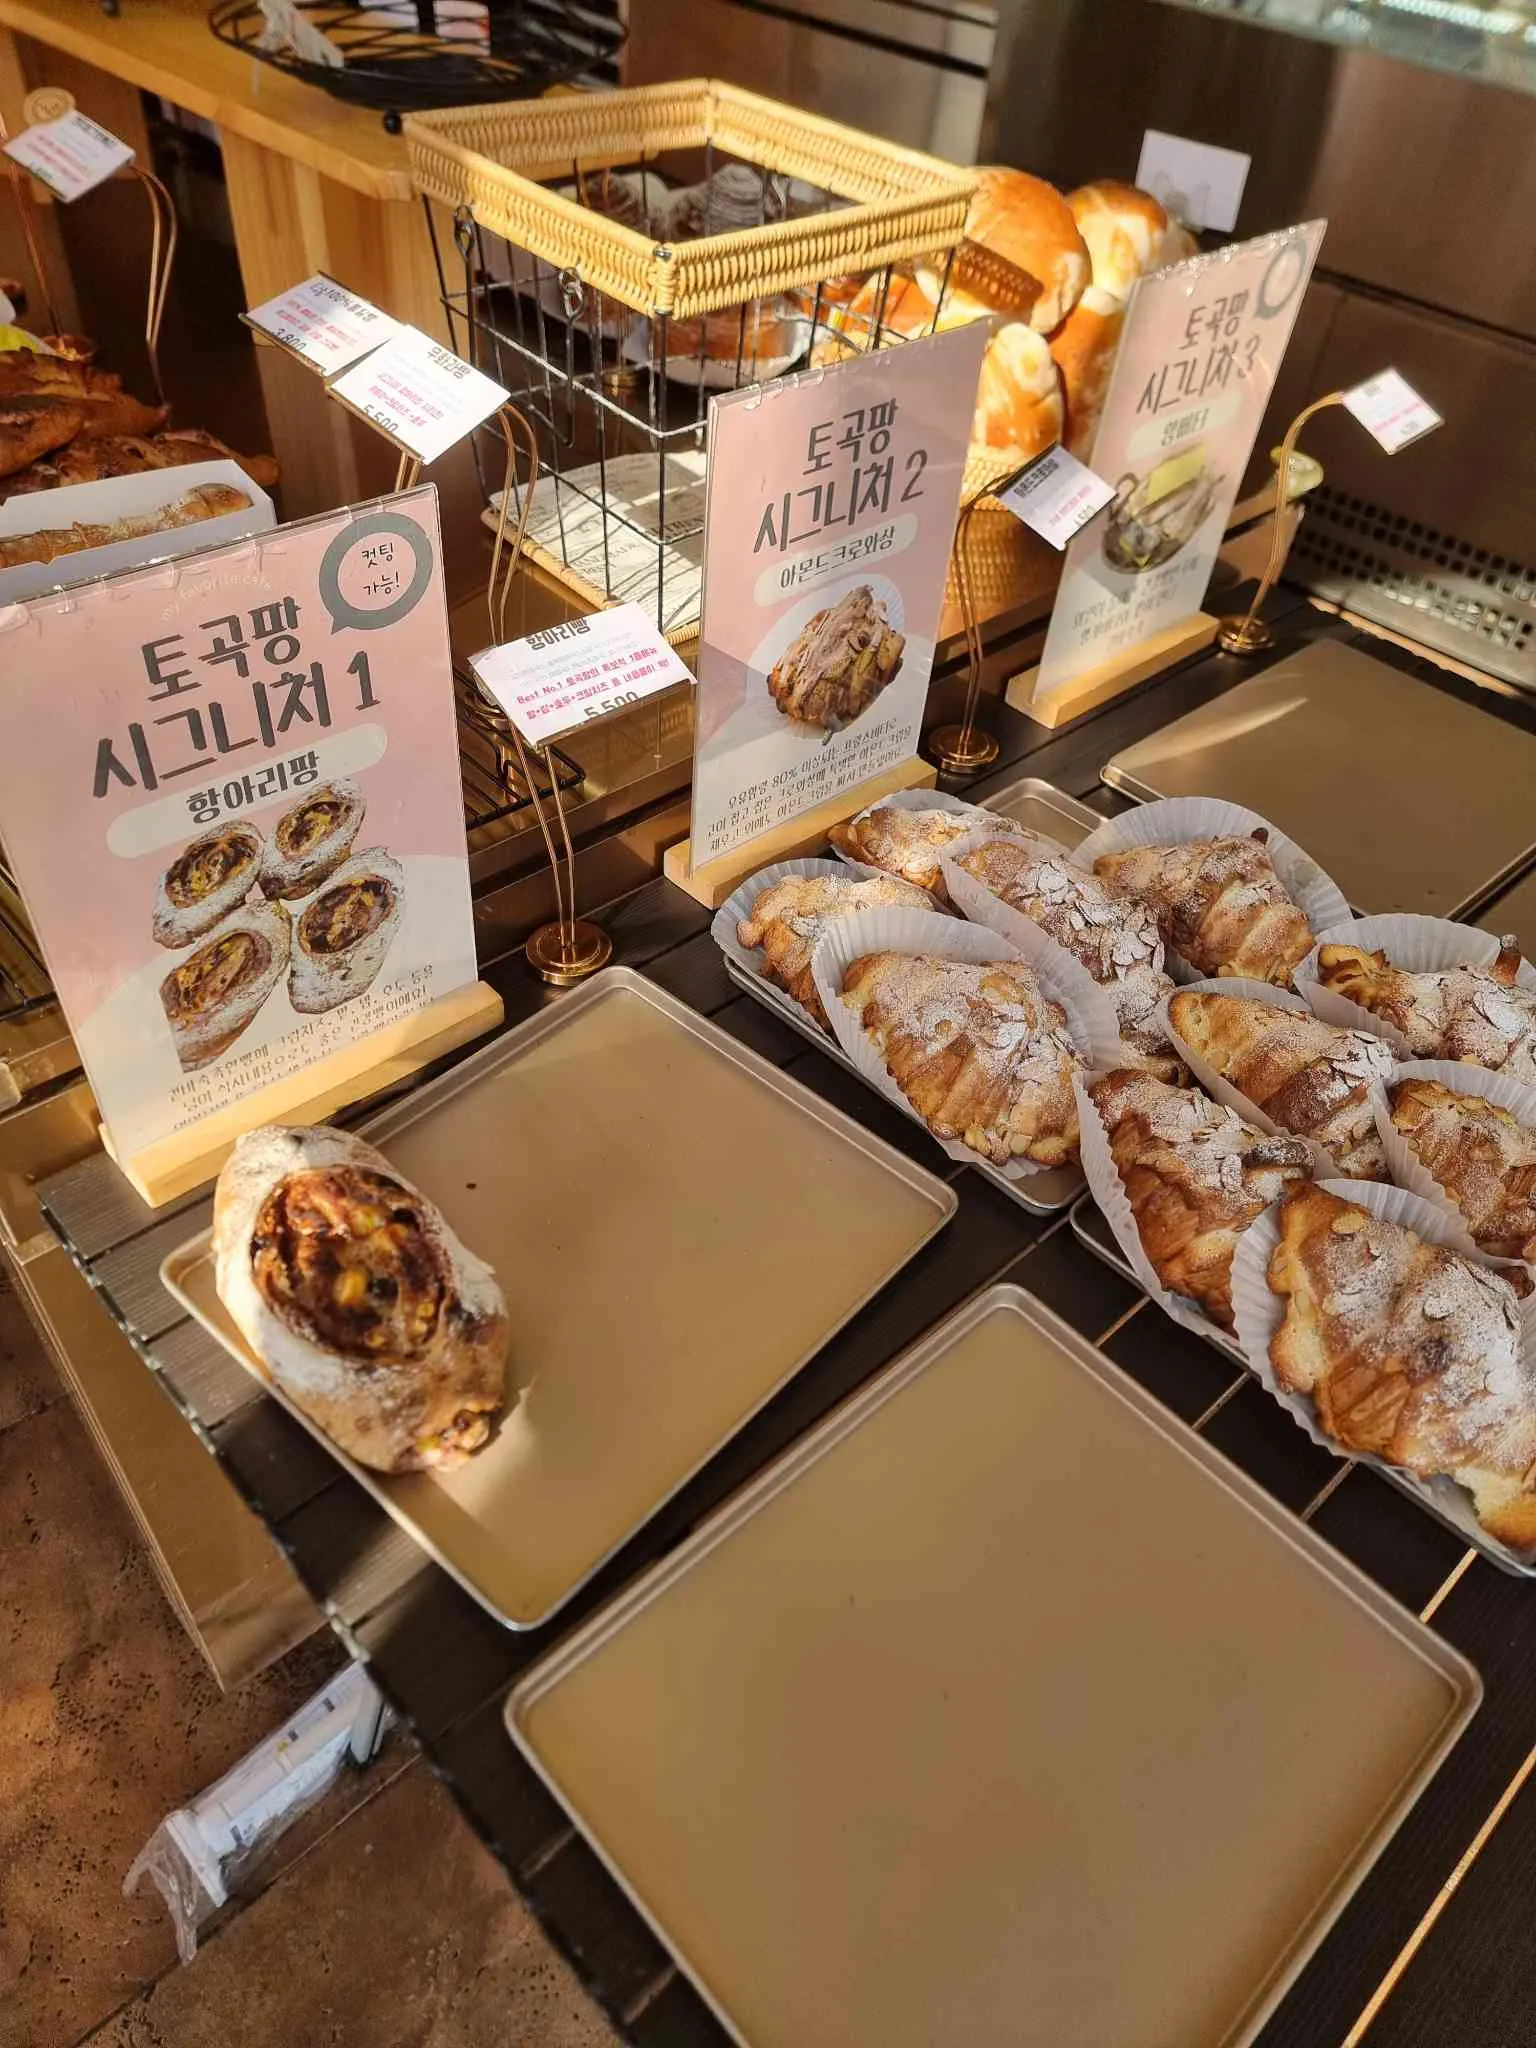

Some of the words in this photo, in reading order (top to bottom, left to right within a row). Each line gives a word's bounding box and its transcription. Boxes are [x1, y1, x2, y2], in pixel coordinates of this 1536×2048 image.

[1178, 289, 1249, 350] 토곡팡
[276, 327, 307, 351] 3800
[1136, 338, 1240, 414] 시그니처
[364, 404, 399, 432] 5500
[802, 398, 899, 476] 토곡팡
[753, 455, 895, 553] 시그니처
[900, 449, 928, 502] 2
[361, 542, 393, 568] 컷팅
[362, 571, 400, 595] 가능!
[142, 596, 302, 701] 토곡팡
[526, 618, 591, 651] 항아리빵
[584, 691, 639, 717] 5500
[93, 661, 332, 798] 시그니처
[346, 650, 381, 711] 1
[772, 767, 798, 788] 80%
